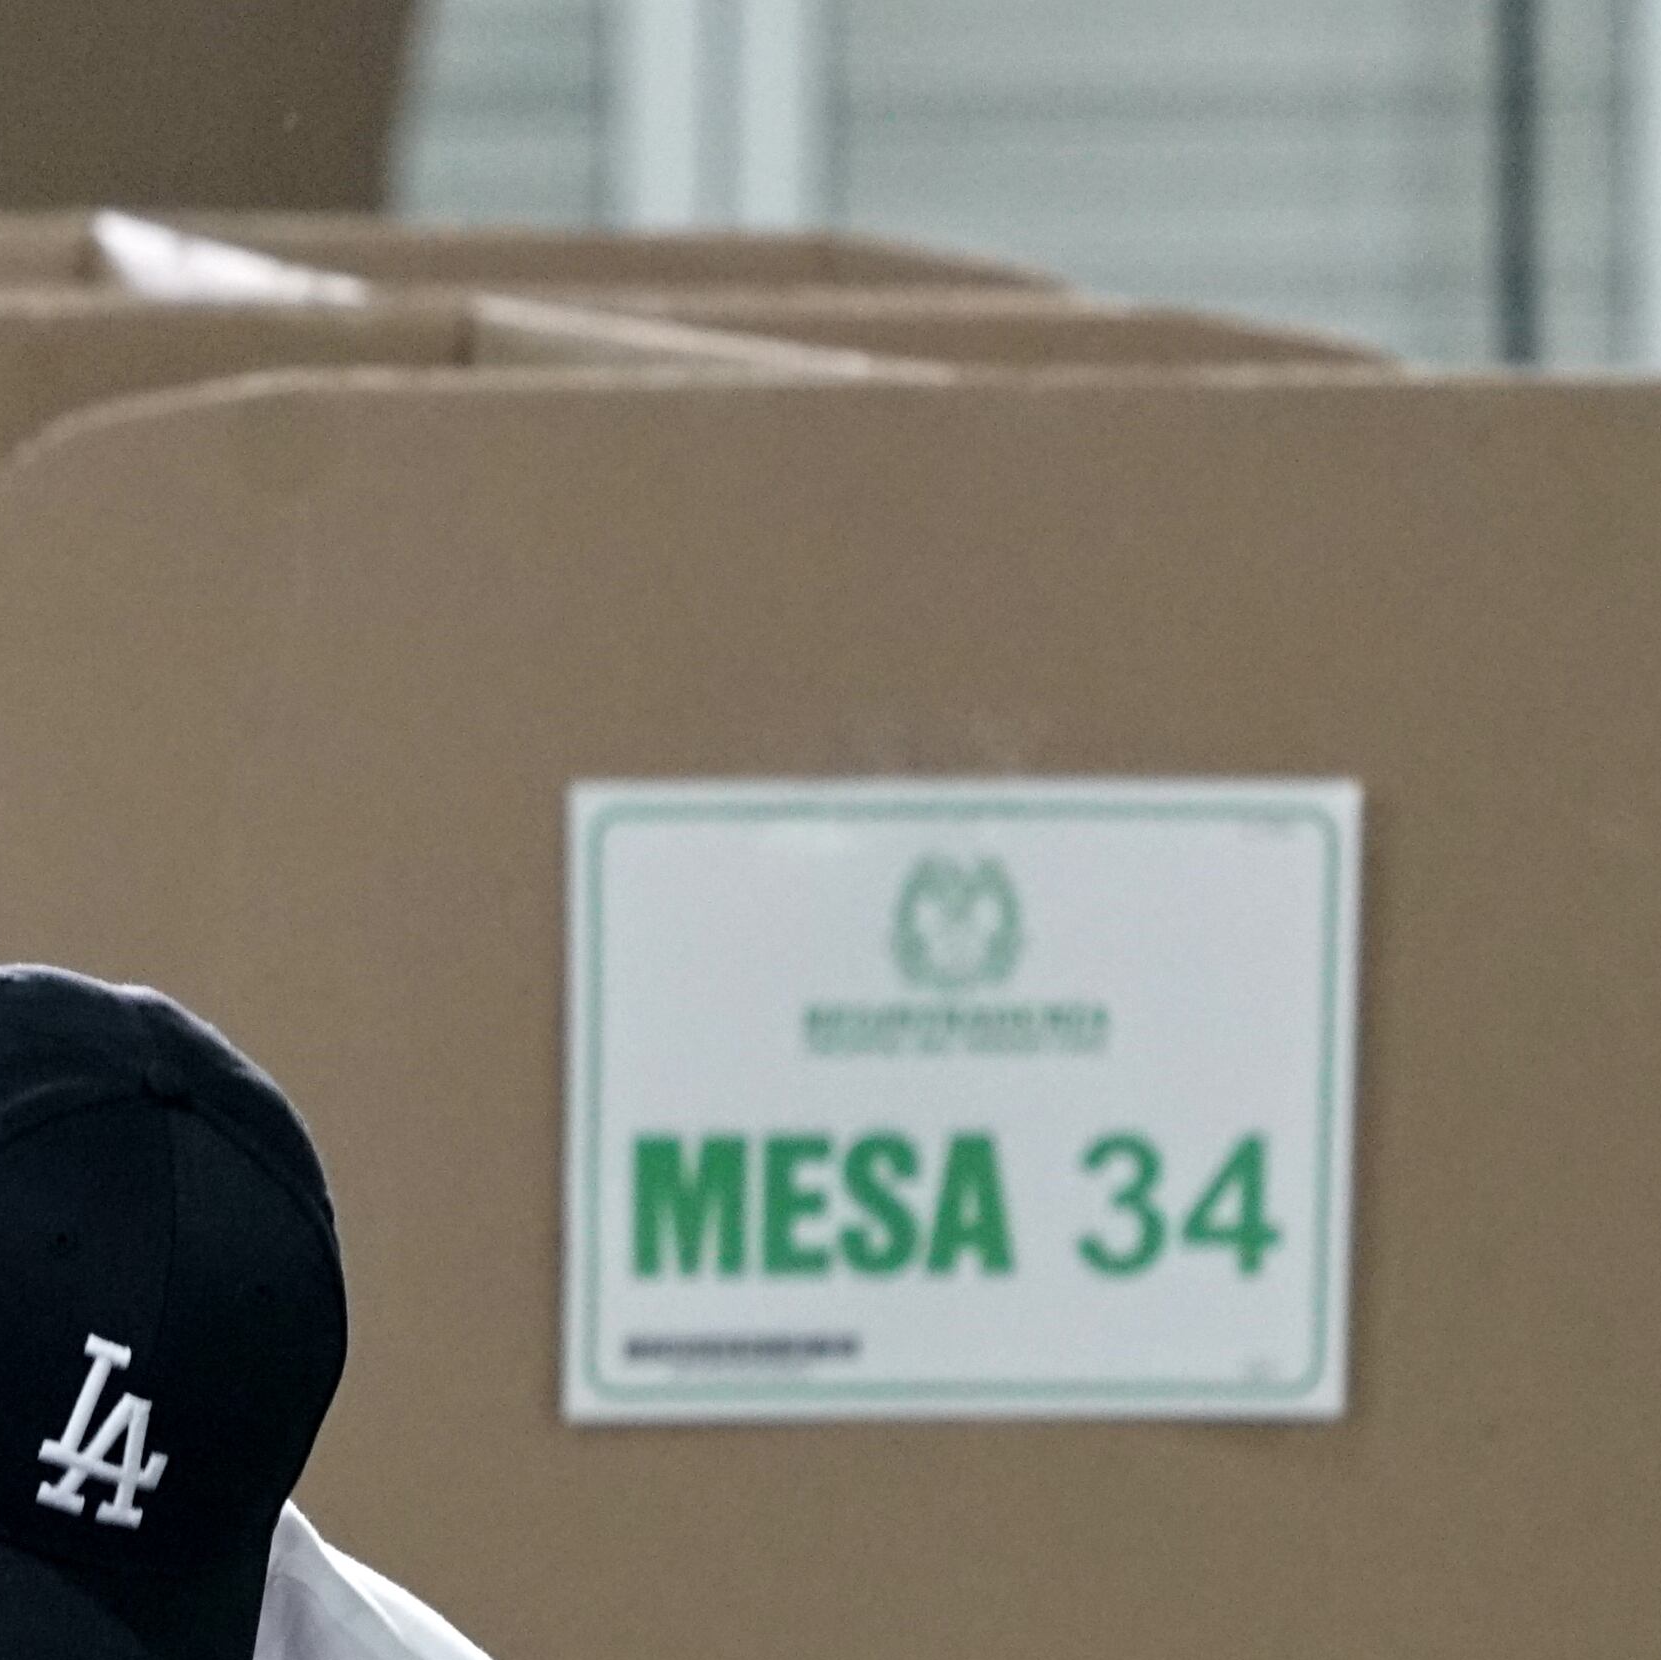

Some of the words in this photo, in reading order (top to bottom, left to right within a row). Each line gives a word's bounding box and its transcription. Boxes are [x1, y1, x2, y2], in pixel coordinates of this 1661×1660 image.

[631, 1130, 1015, 1279] MESA
[1077, 1131, 1281, 1279] 34
[36, 1332, 169, 1529] LA
